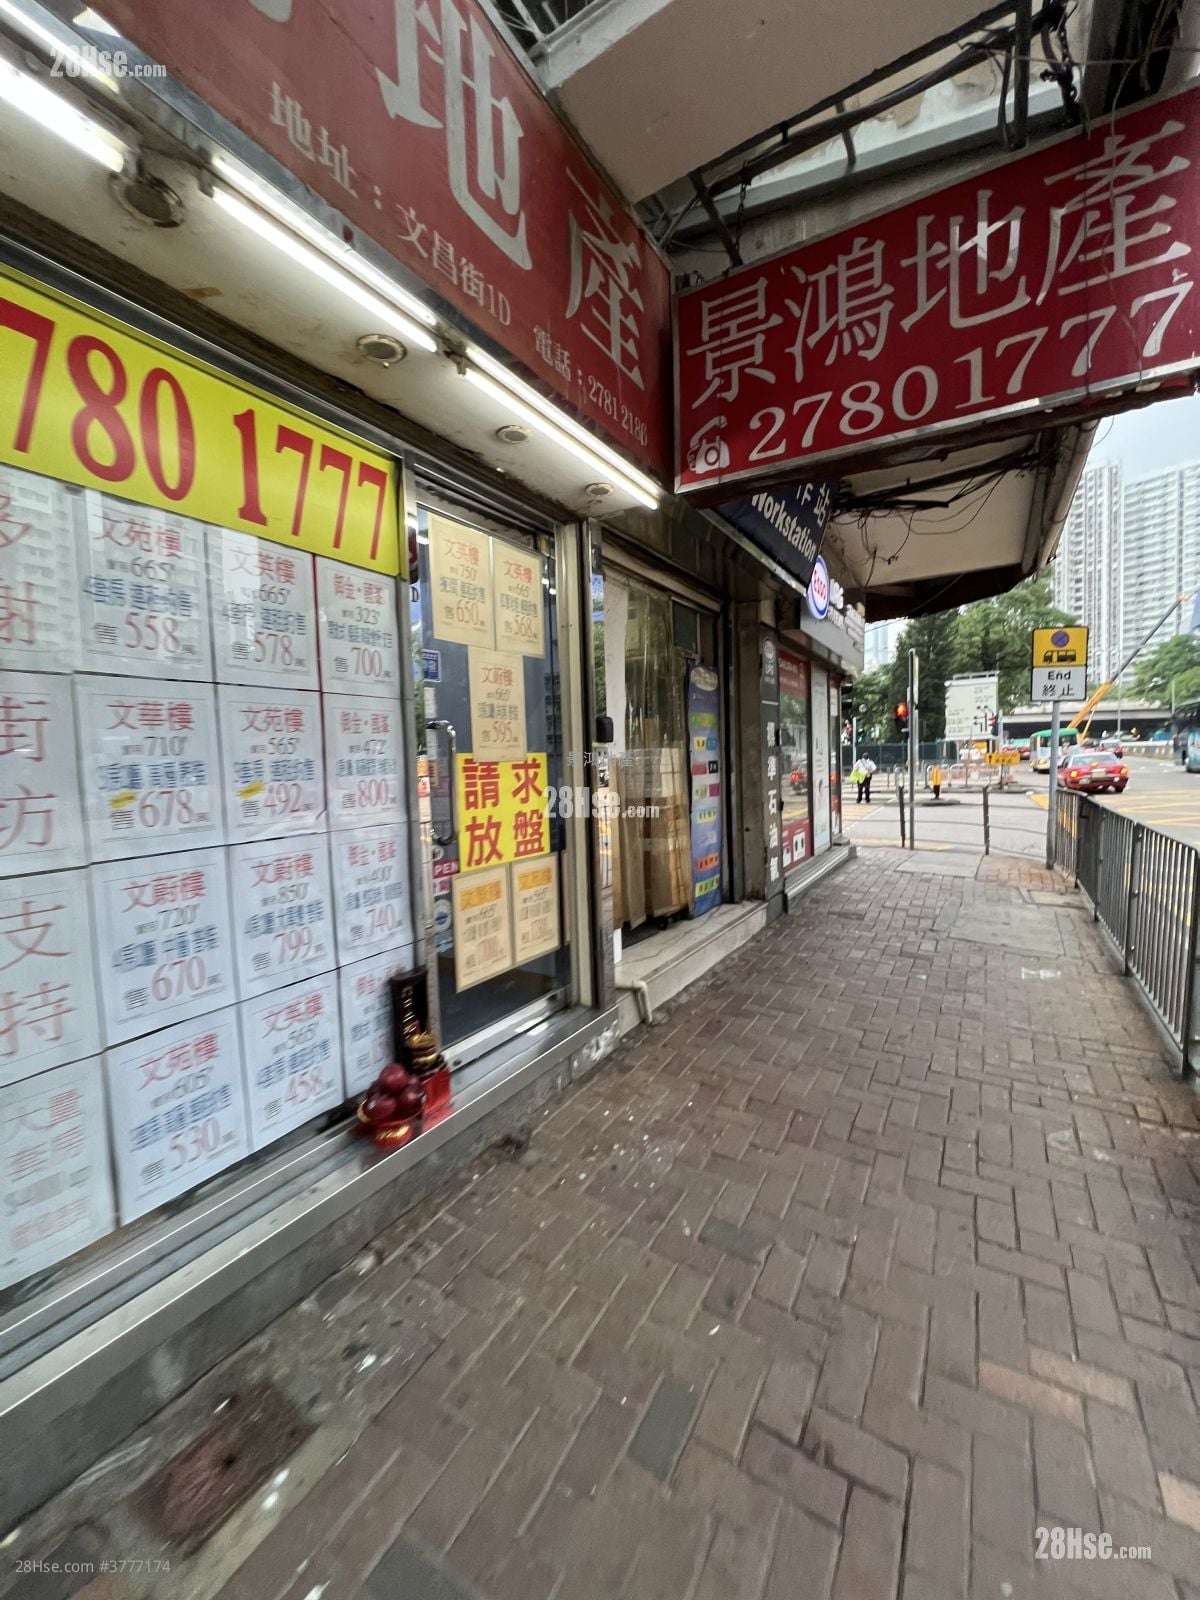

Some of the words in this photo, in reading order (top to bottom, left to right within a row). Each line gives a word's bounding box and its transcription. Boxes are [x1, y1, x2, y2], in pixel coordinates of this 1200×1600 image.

[686, 119, 1193, 409] 景鴻地產
[233, 408, 388, 561] 1777
[1041, 683, 1075, 697] 終止
[1047, 670, 1072, 681] End
